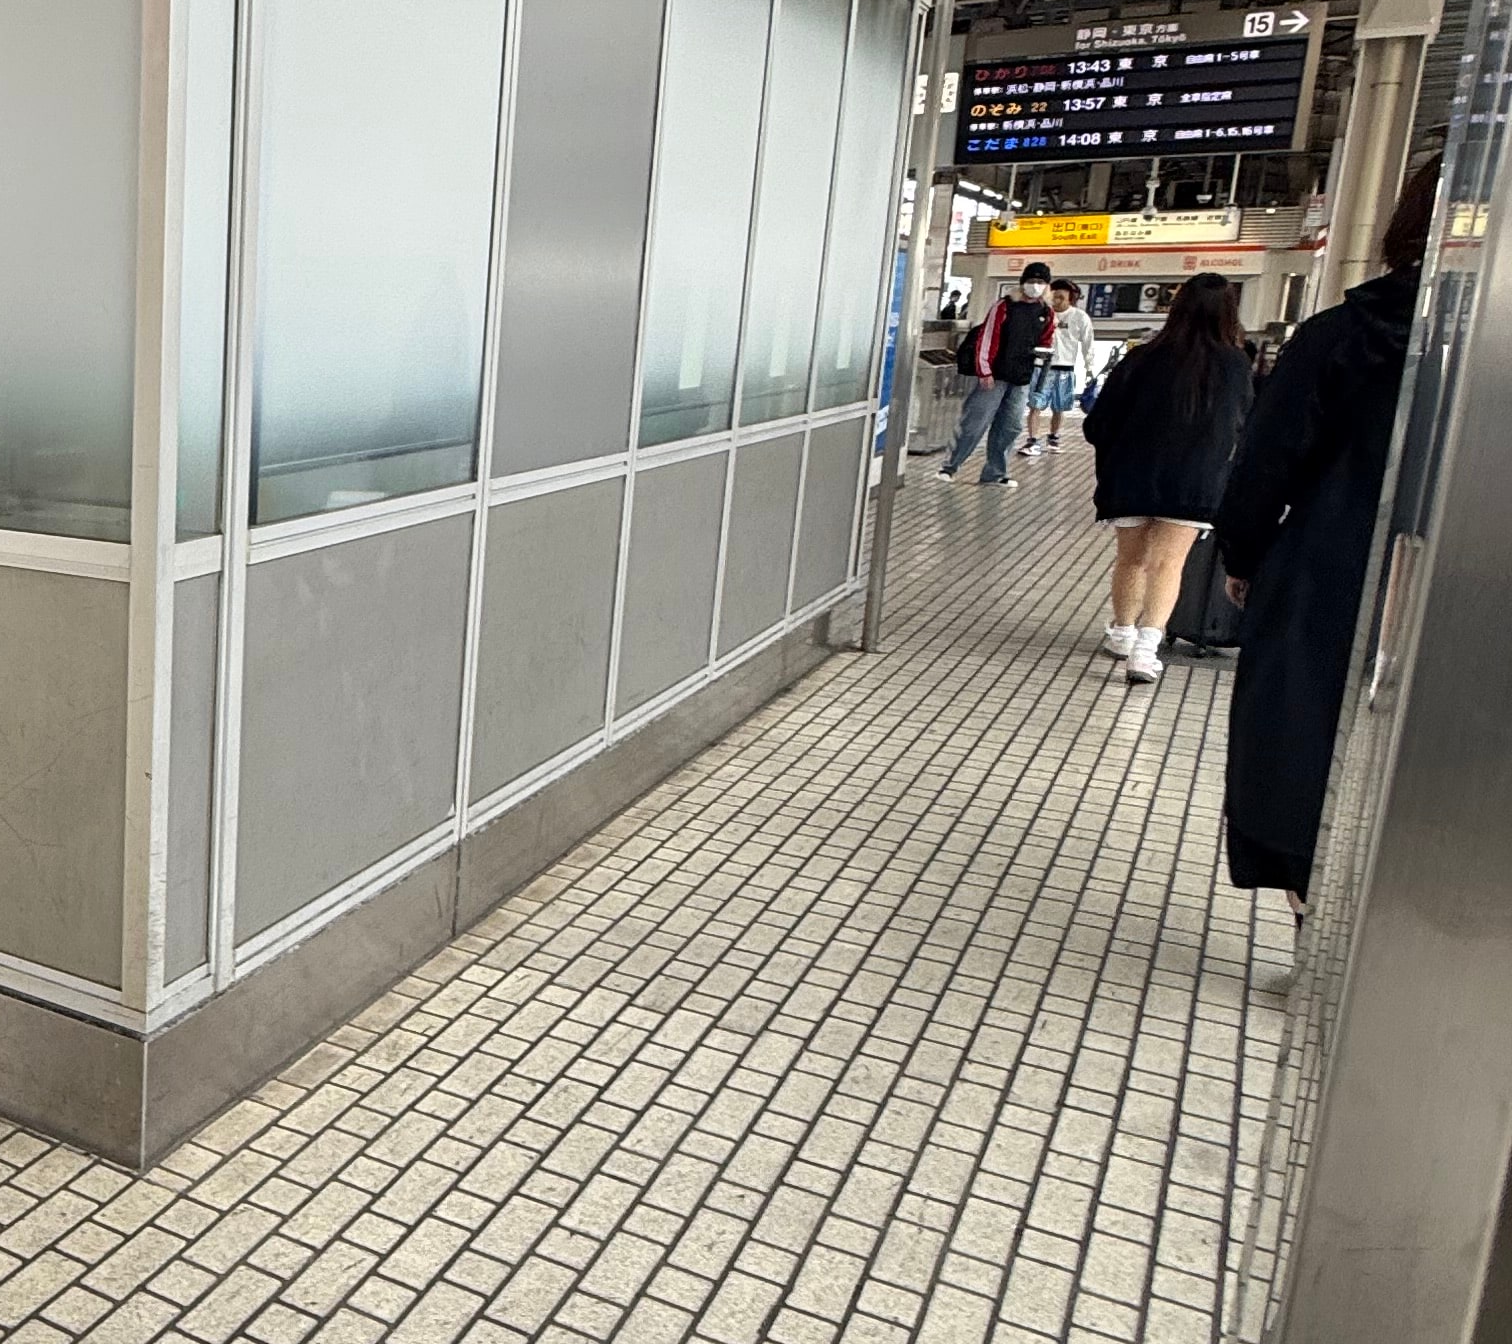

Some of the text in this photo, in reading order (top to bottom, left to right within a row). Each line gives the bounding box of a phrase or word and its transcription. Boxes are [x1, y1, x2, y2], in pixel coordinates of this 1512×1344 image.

[1249, 15, 1270, 34] 15
[1067, 59, 1111, 74] 13:43
[970, 102, 1022, 117] のぞみ
[1031, 102, 1048, 113] 22
[1063, 97, 1106, 111] 13:57
[967, 138, 1019, 151] こだま
[1058, 133, 1101, 146] 14:08
